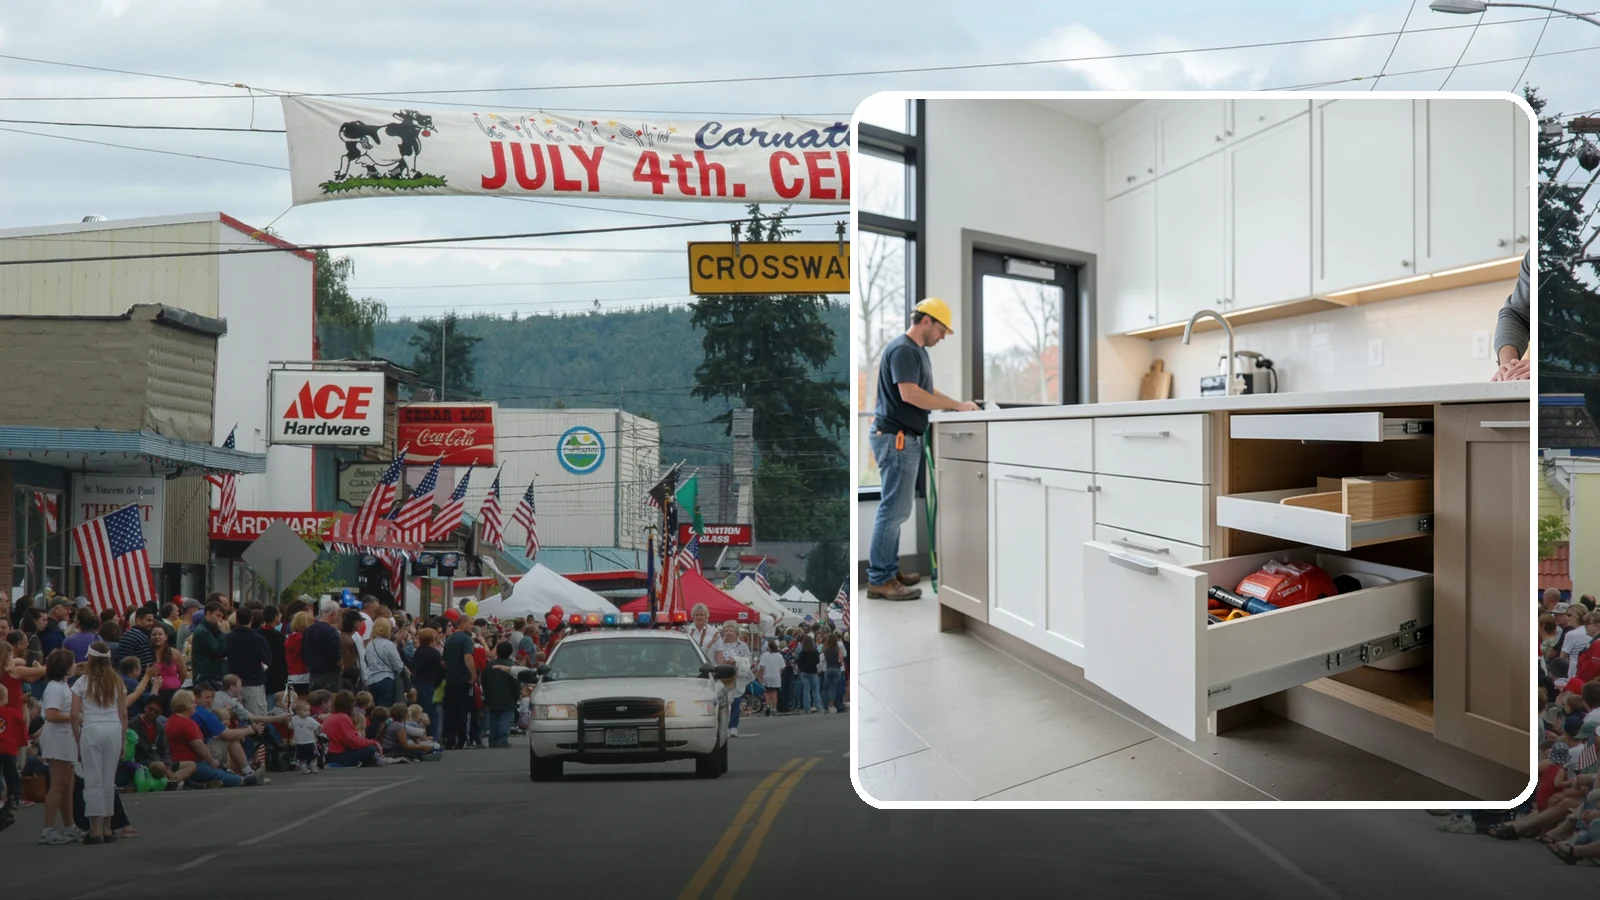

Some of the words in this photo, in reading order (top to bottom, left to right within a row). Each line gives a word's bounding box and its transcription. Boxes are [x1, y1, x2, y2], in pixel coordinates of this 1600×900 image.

[695, 121, 850, 149] Carnat
[481, 141, 604, 192] JULY
[632, 150, 746, 197] 4th.
[697, 254, 850, 280] CROSSWA
[283, 380, 373, 420] ACE
[406, 409, 452, 422] CEDAR
[283, 421, 371, 436] Hardware
[416, 428, 476, 447] Coca-Cola
[354, 467, 384, 480] Simpl
[83, 485, 93, 494] St.
[96, 485, 124, 494] Vincent
[126, 485, 136, 494] de
[138, 486, 155, 495] Paul
[212, 516, 331, 536] HARDARE
[688, 526, 741, 534] CRNATION
[699, 535, 730, 543] GLASS
